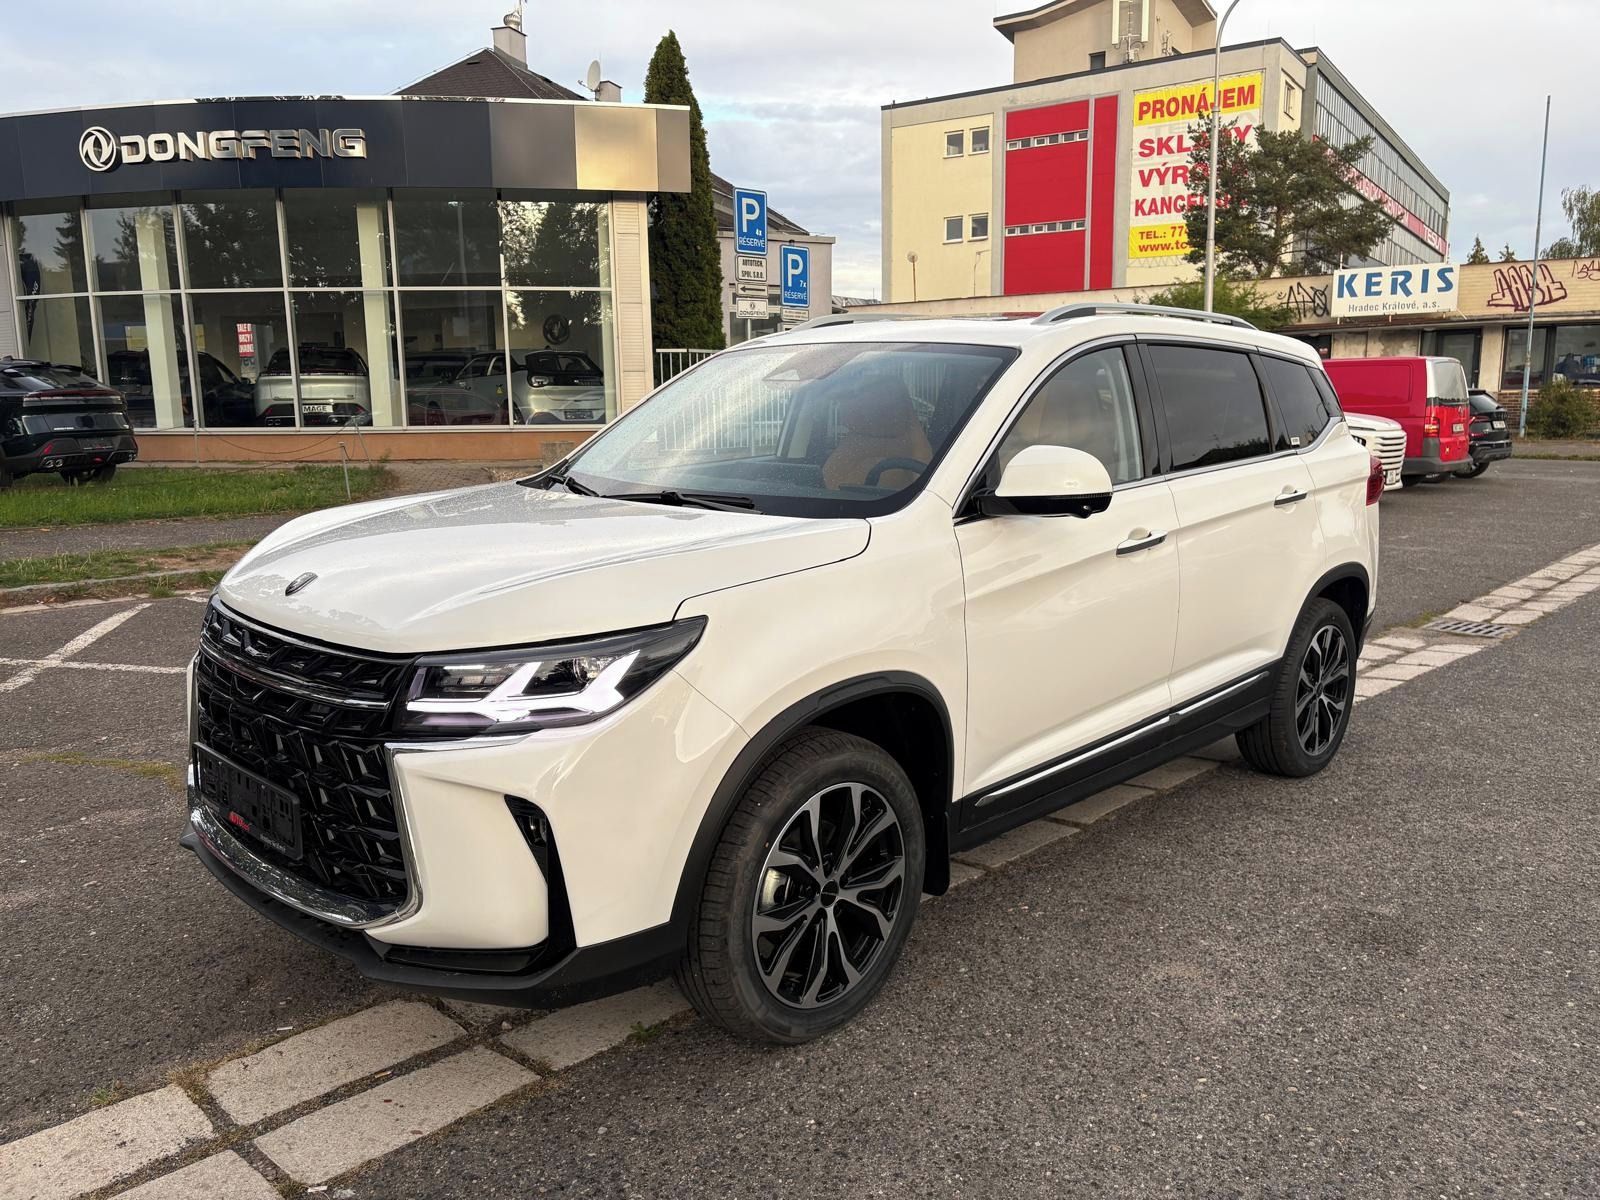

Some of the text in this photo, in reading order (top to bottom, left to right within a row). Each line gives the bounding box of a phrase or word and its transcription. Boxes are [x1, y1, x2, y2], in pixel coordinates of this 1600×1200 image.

[120, 128, 367, 164] DONGFENG
[742, 197, 760, 233] P
[787, 253, 804, 287] P
[1337, 267, 1456, 298] KERIS
[1348, 301, 1440, 313] Hradec Králové, a.s.
